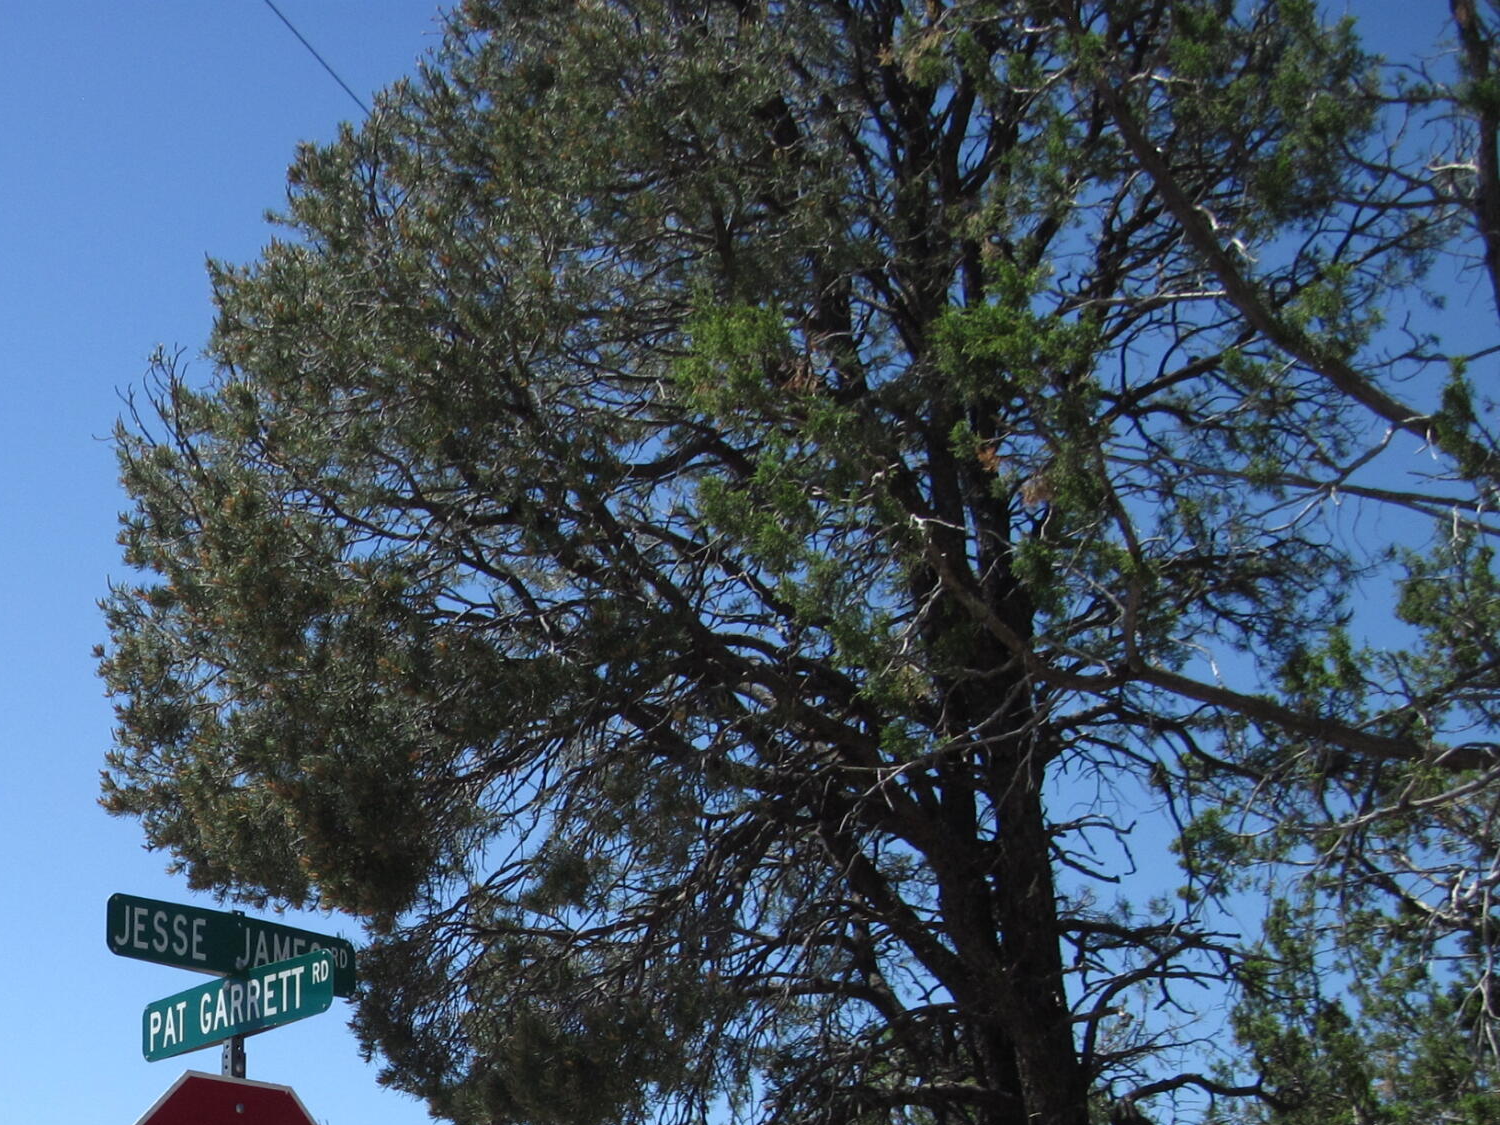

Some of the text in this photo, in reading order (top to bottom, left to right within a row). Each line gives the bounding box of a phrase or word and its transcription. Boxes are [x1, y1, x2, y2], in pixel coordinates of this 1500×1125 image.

[114, 904, 207, 961] JESSE
[235, 927, 321, 970] JAM
[149, 959, 329, 1052] PAT GARRETT RD
